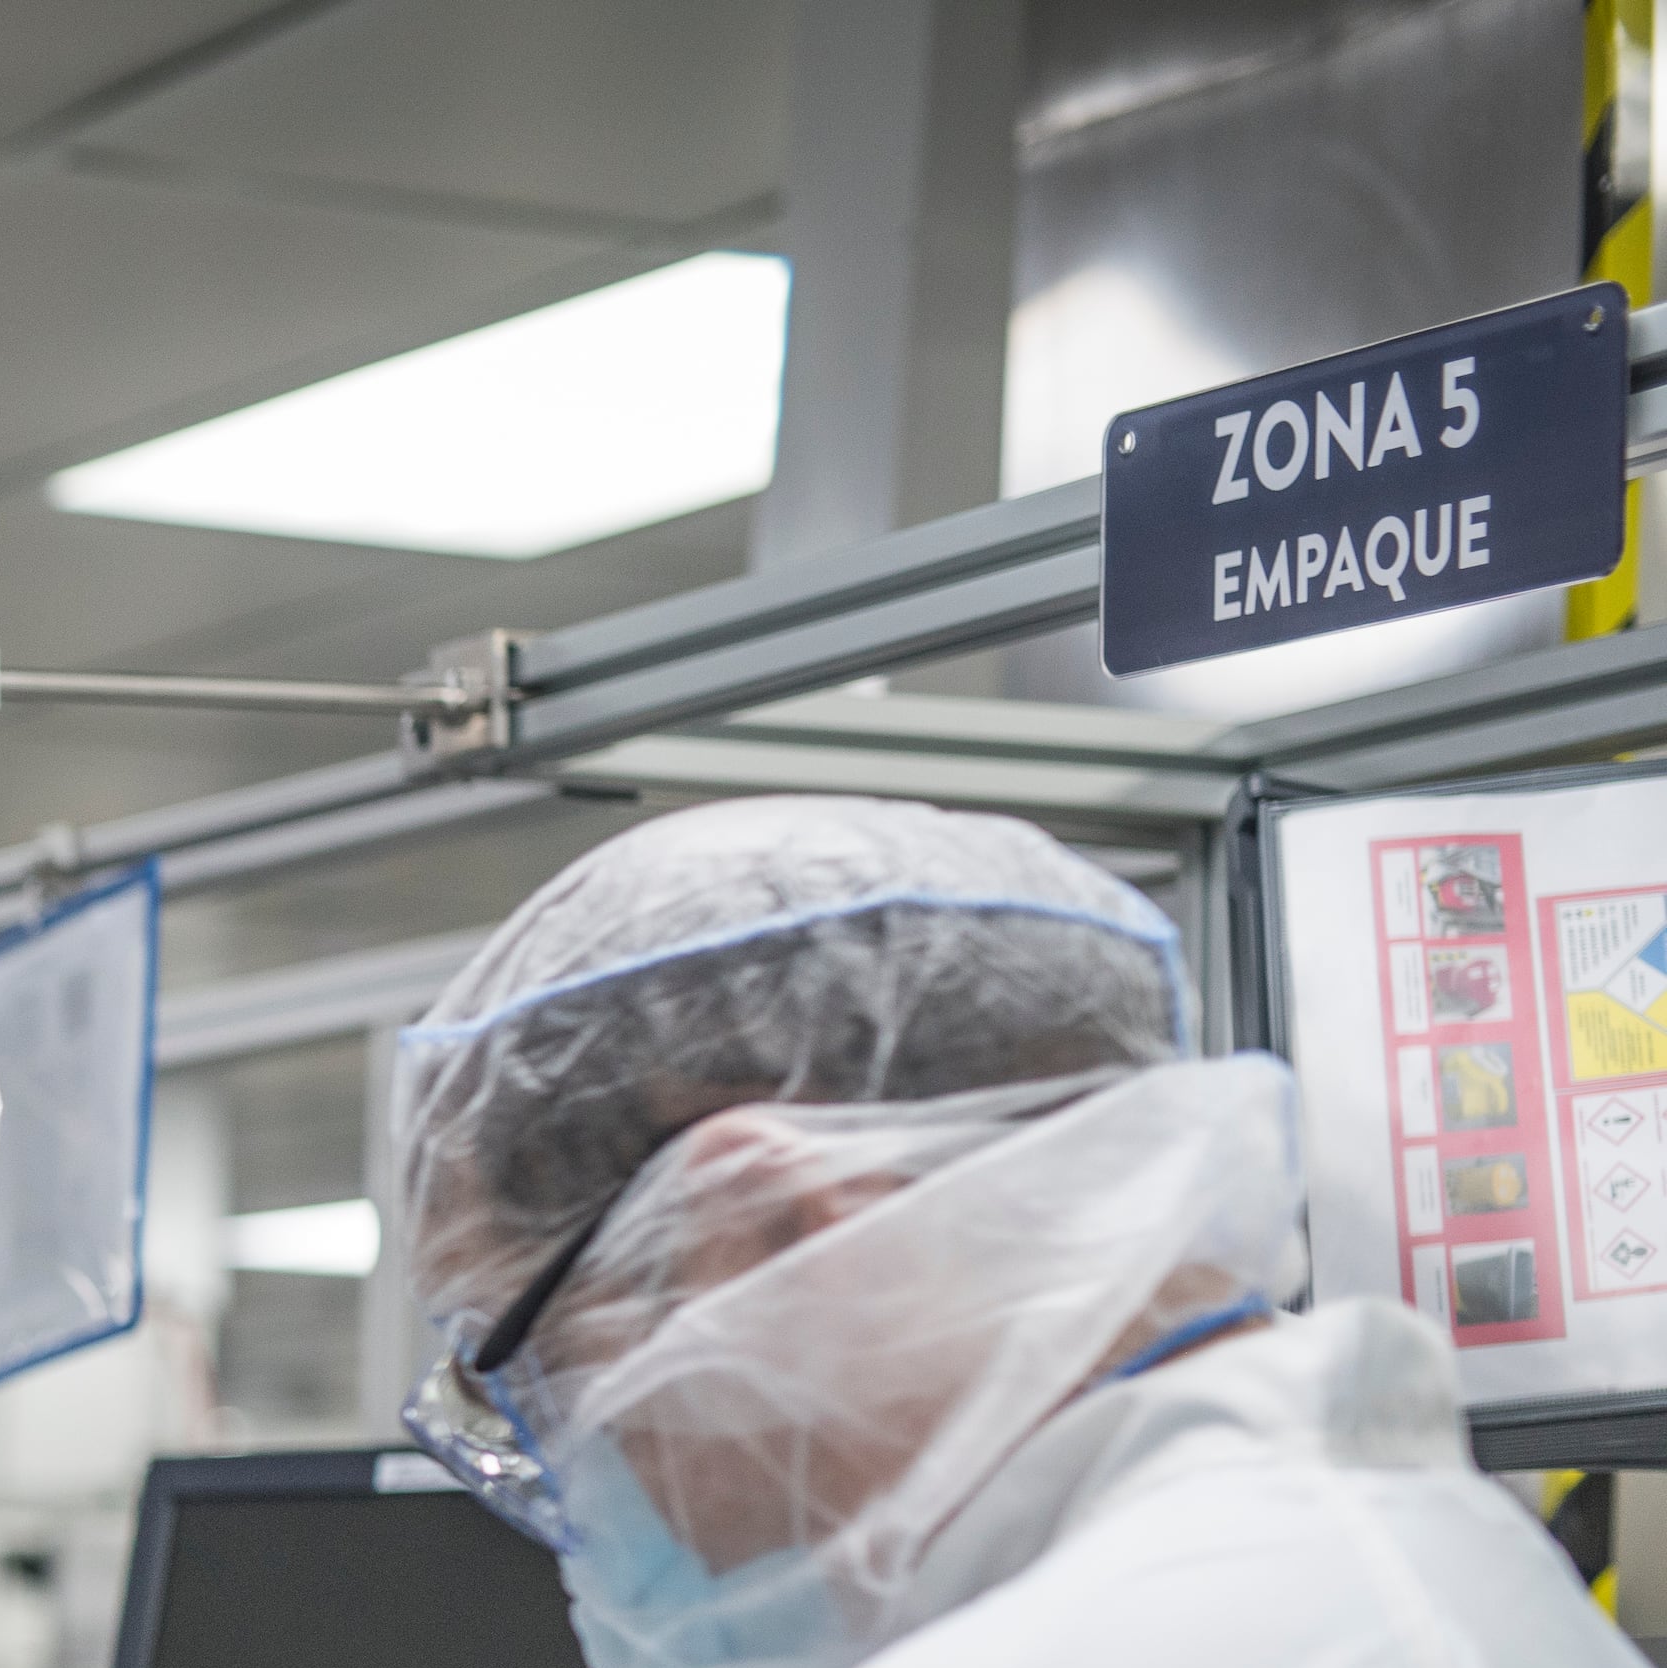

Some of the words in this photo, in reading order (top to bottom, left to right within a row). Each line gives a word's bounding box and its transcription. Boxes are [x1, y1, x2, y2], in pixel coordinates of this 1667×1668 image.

[1212, 371, 1422, 505] ZONA
[1440, 356, 1480, 448] 5
[1213, 494, 1491, 622] EMPAQUE
